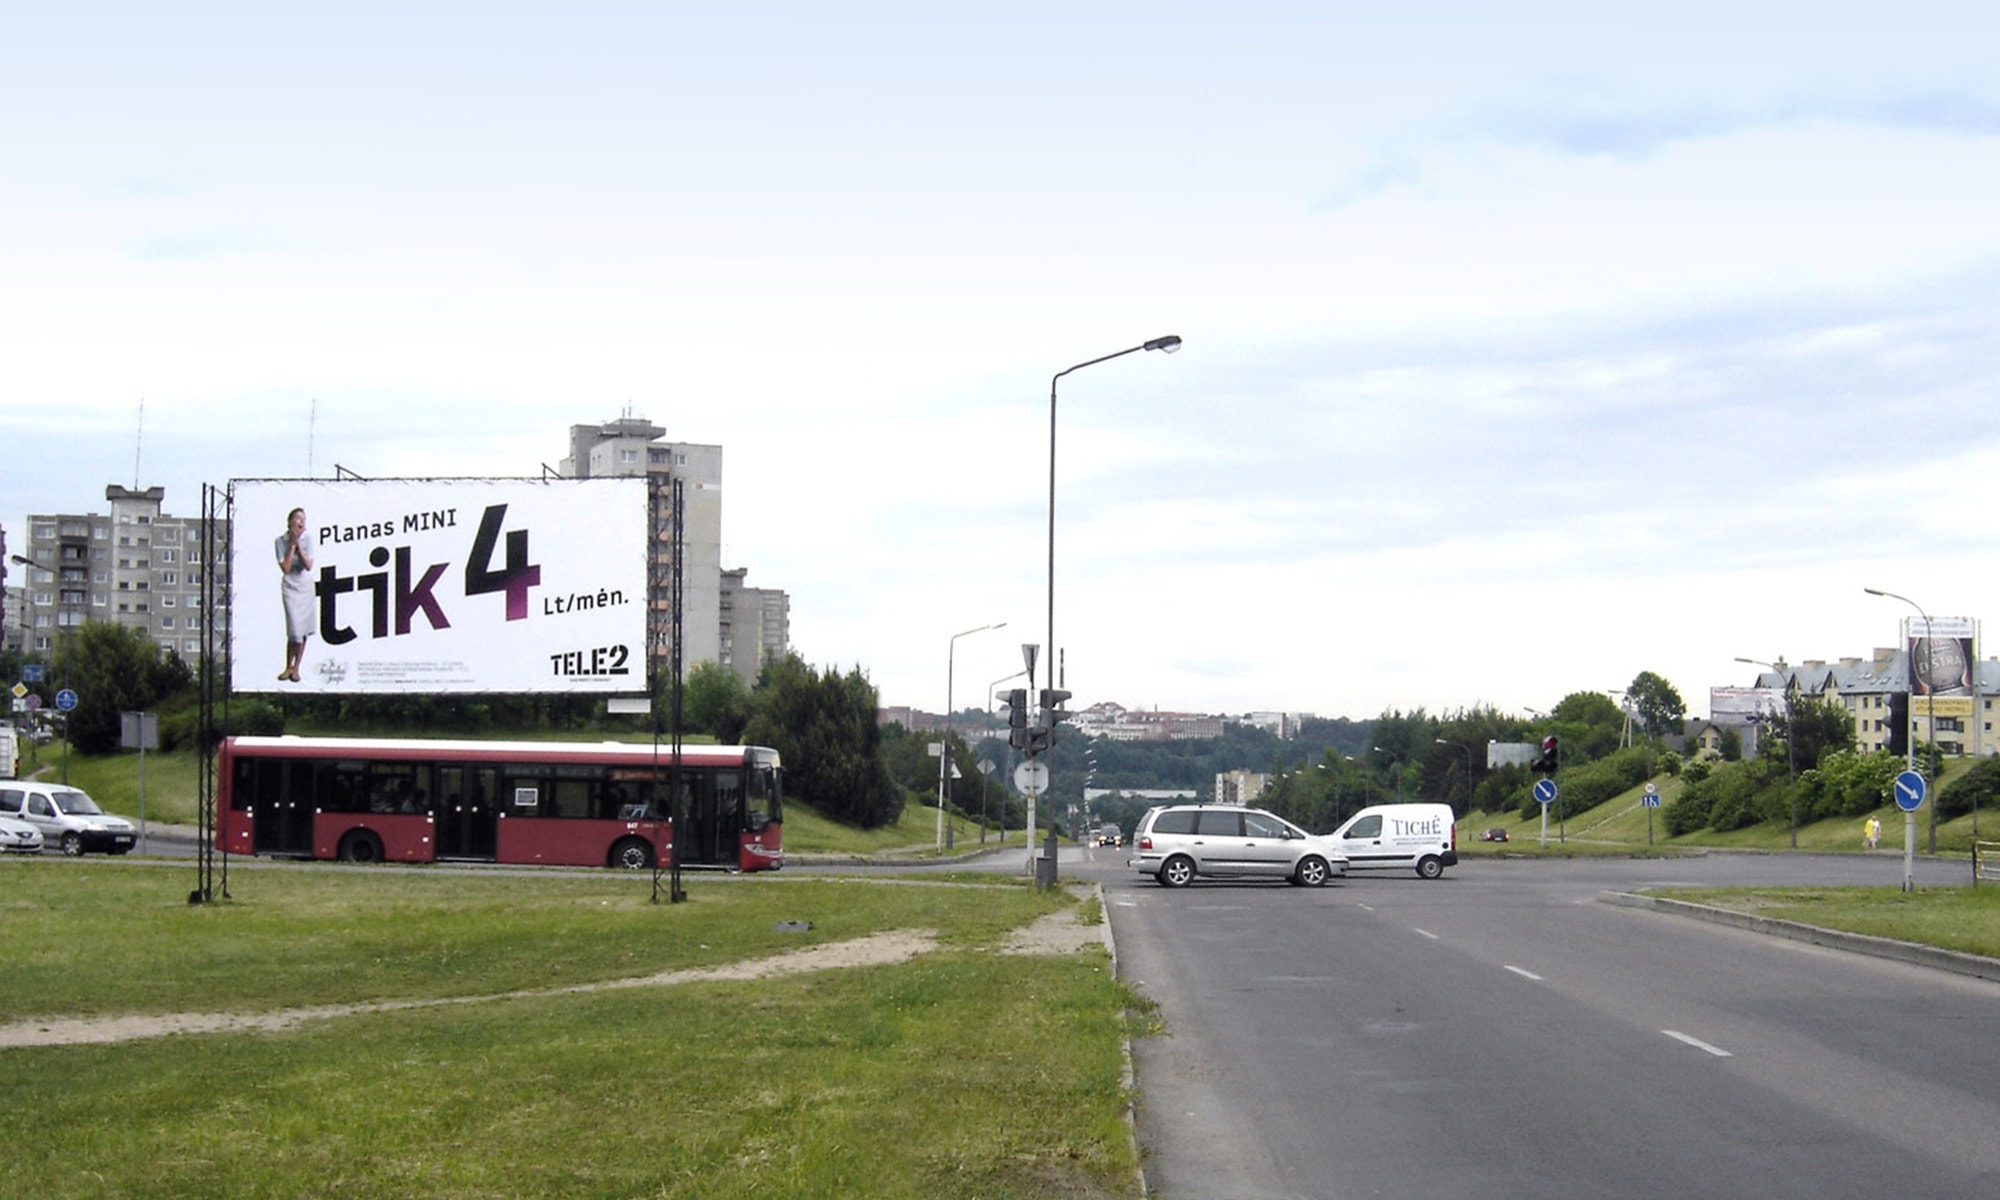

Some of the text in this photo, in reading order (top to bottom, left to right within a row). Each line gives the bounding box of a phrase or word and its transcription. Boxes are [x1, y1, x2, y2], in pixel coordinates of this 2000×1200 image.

[319, 508, 457, 546] Planas MINI
[314, 503, 629, 646] tik 4 Lt/mėn.
[550, 644, 629, 676] TELE2
